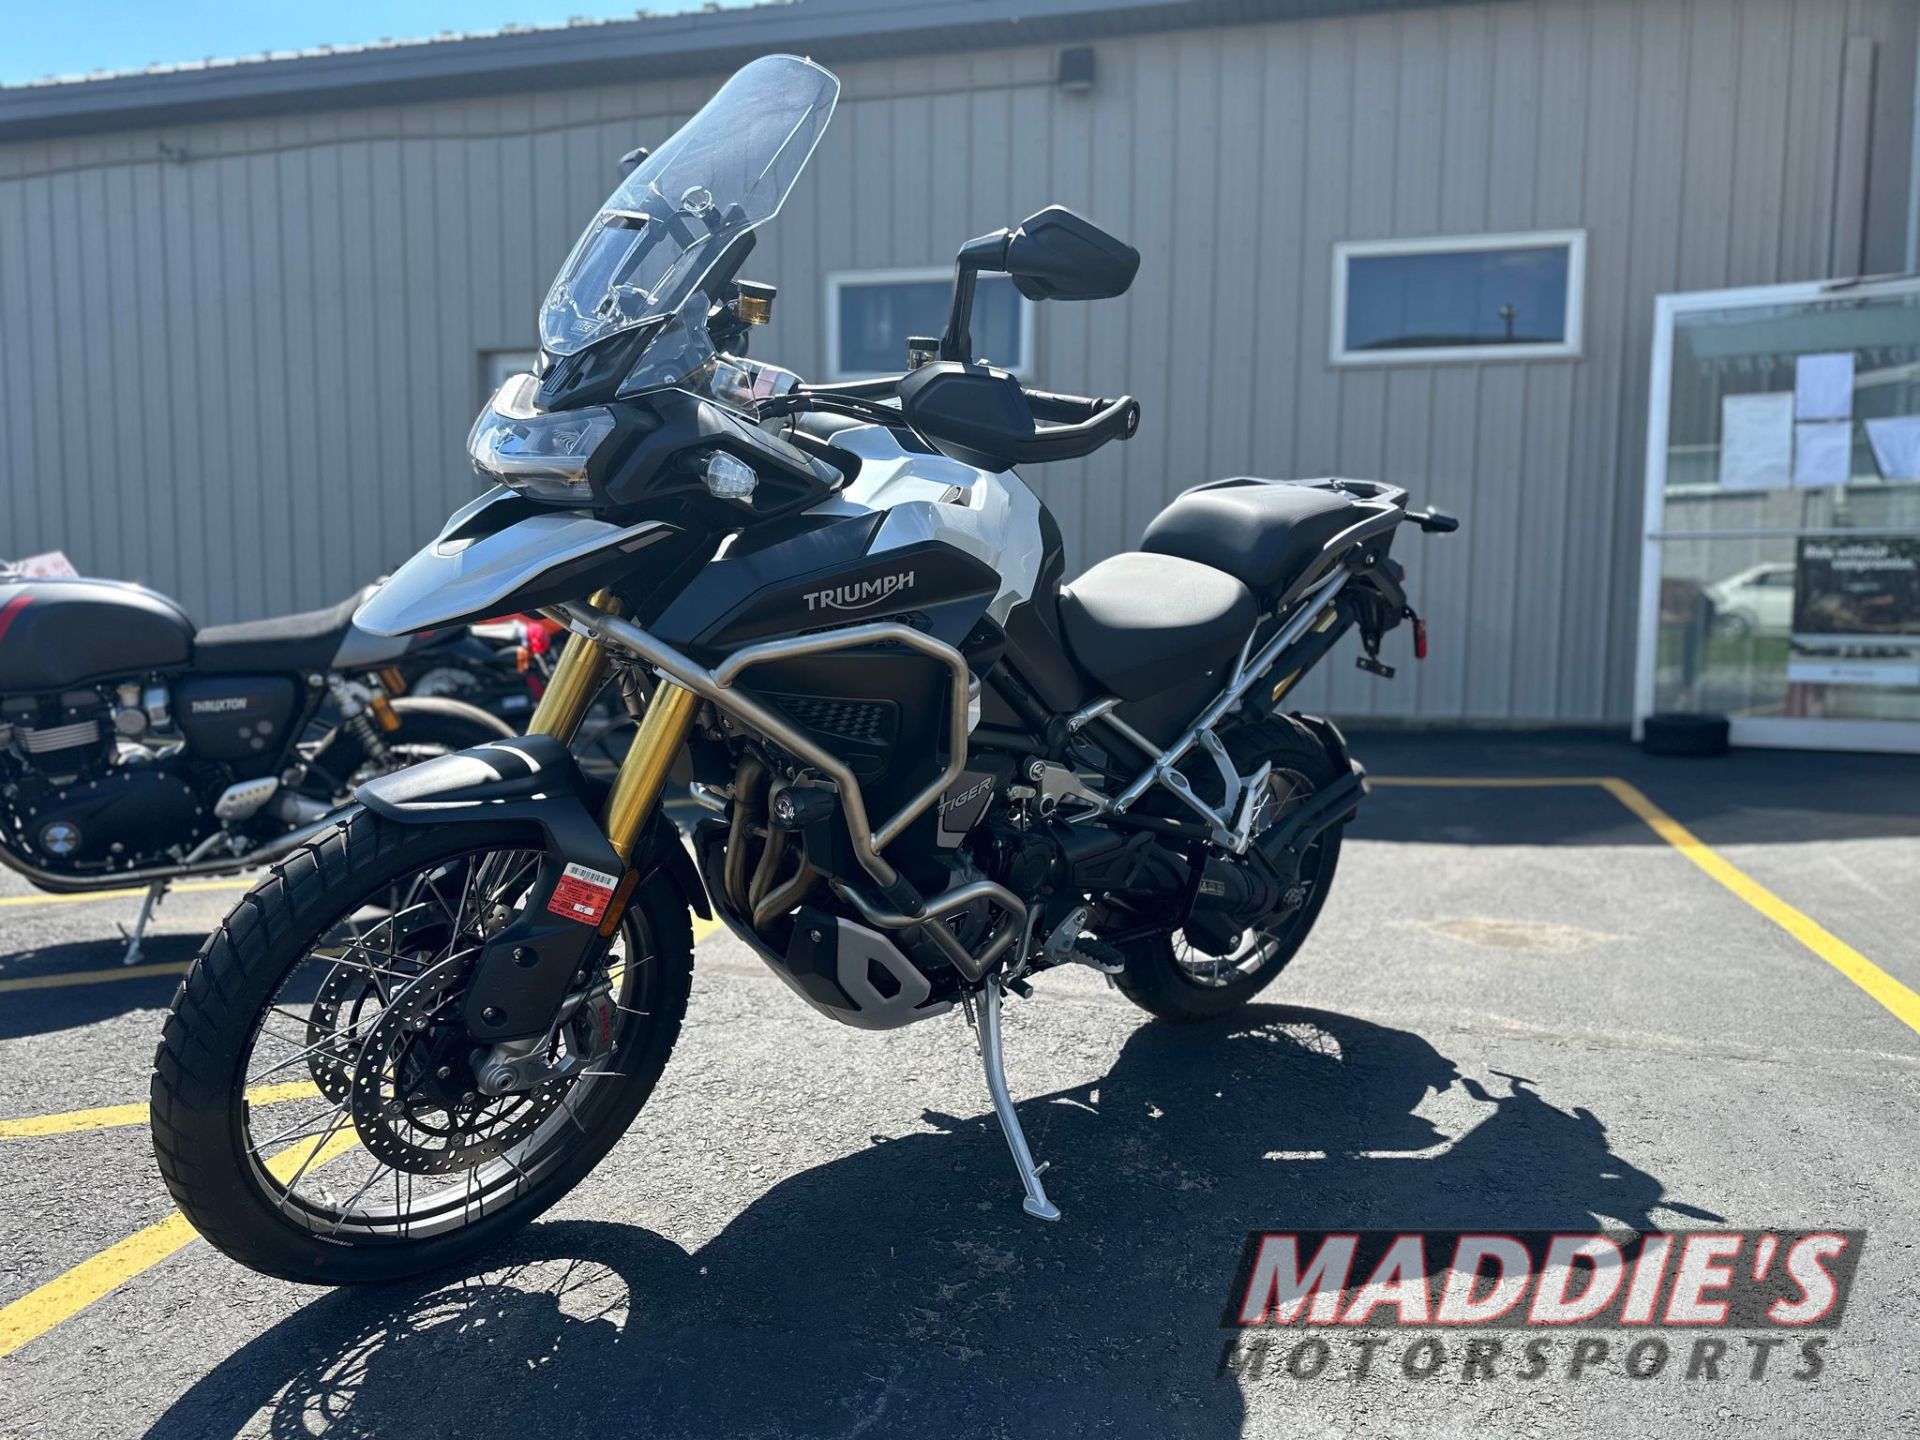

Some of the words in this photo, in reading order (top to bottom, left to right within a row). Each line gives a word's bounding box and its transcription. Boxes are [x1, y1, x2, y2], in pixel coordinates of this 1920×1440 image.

[803, 571, 914, 611] TRIUMPH
[192, 697, 247, 713] THRUXTON
[937, 776, 992, 816] TIGER
